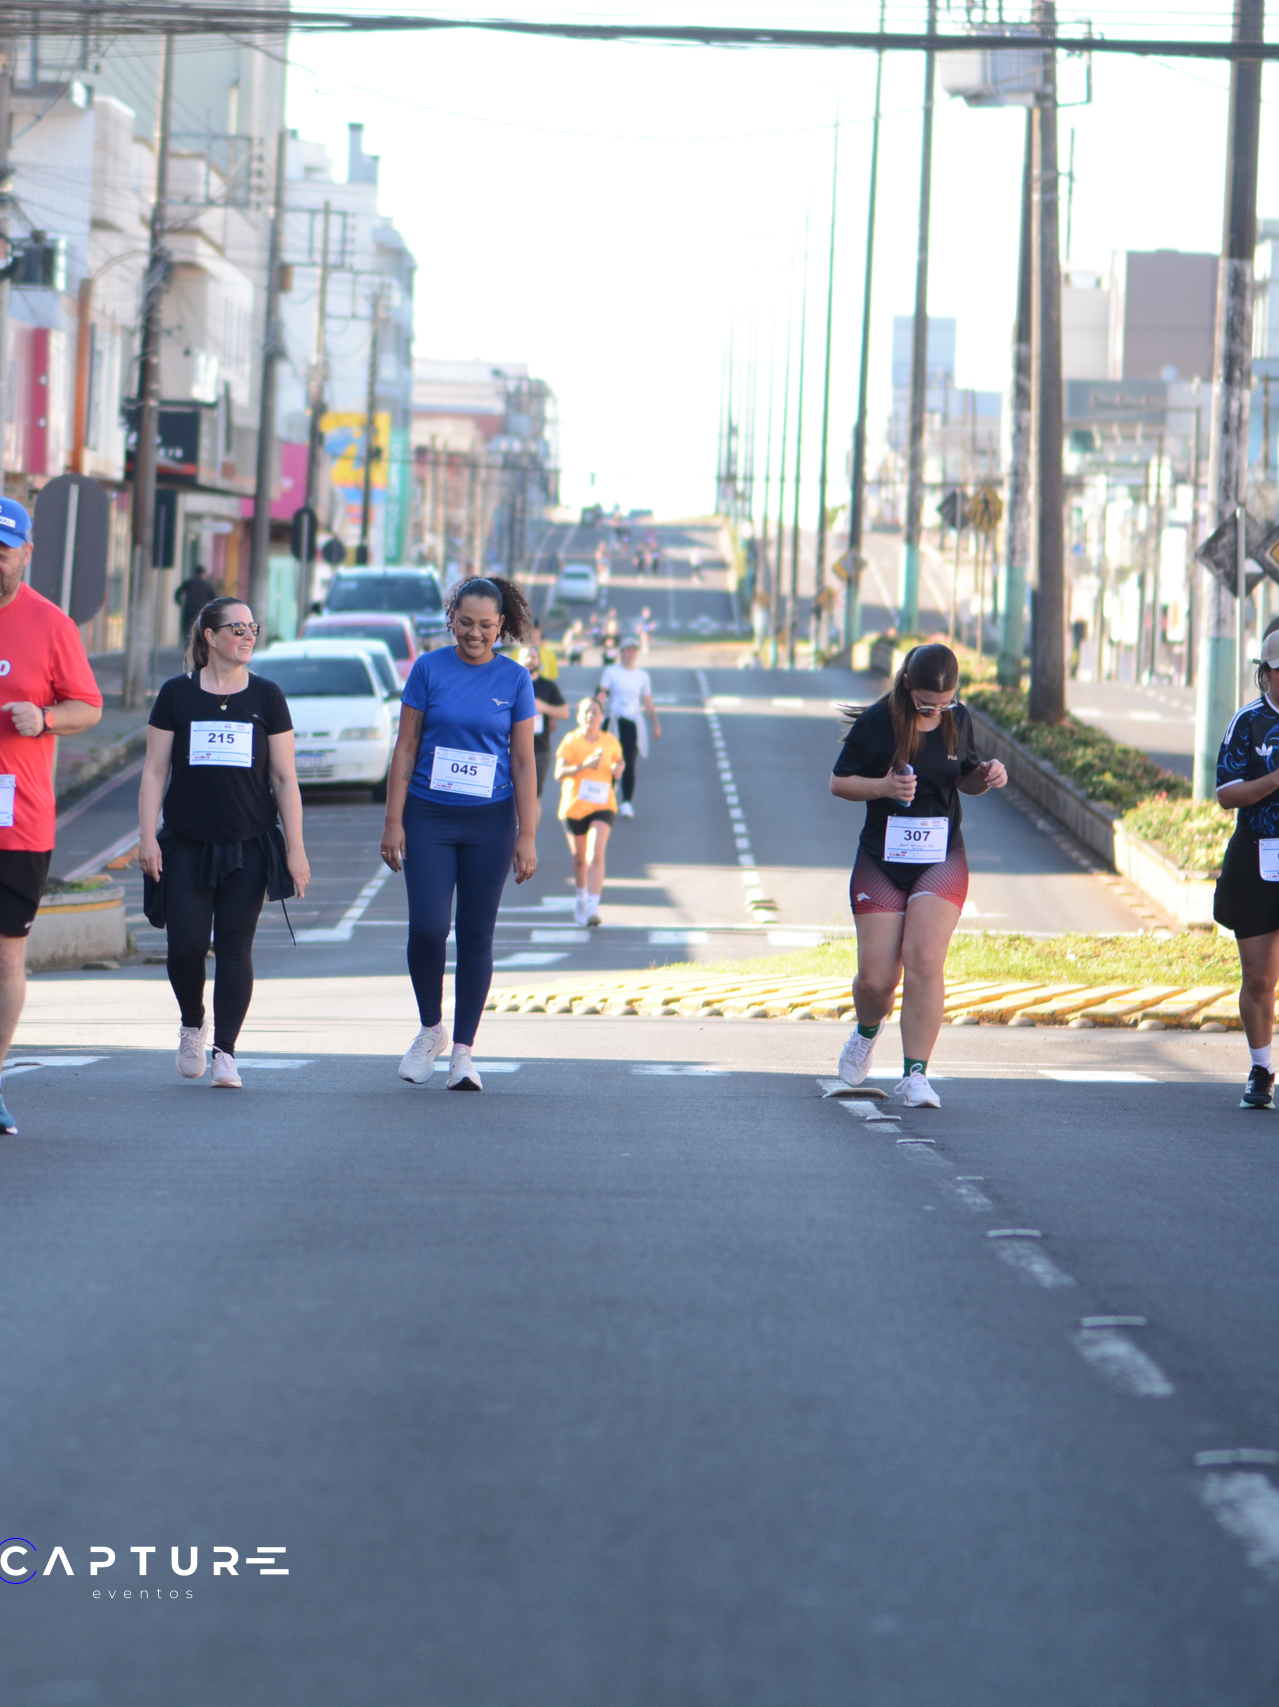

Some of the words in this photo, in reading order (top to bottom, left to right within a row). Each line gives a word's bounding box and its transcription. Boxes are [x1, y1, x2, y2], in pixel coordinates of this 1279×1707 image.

[207, 732, 235, 744] 215
[451, 762, 478, 776] 045
[903, 829, 931, 842] 307
